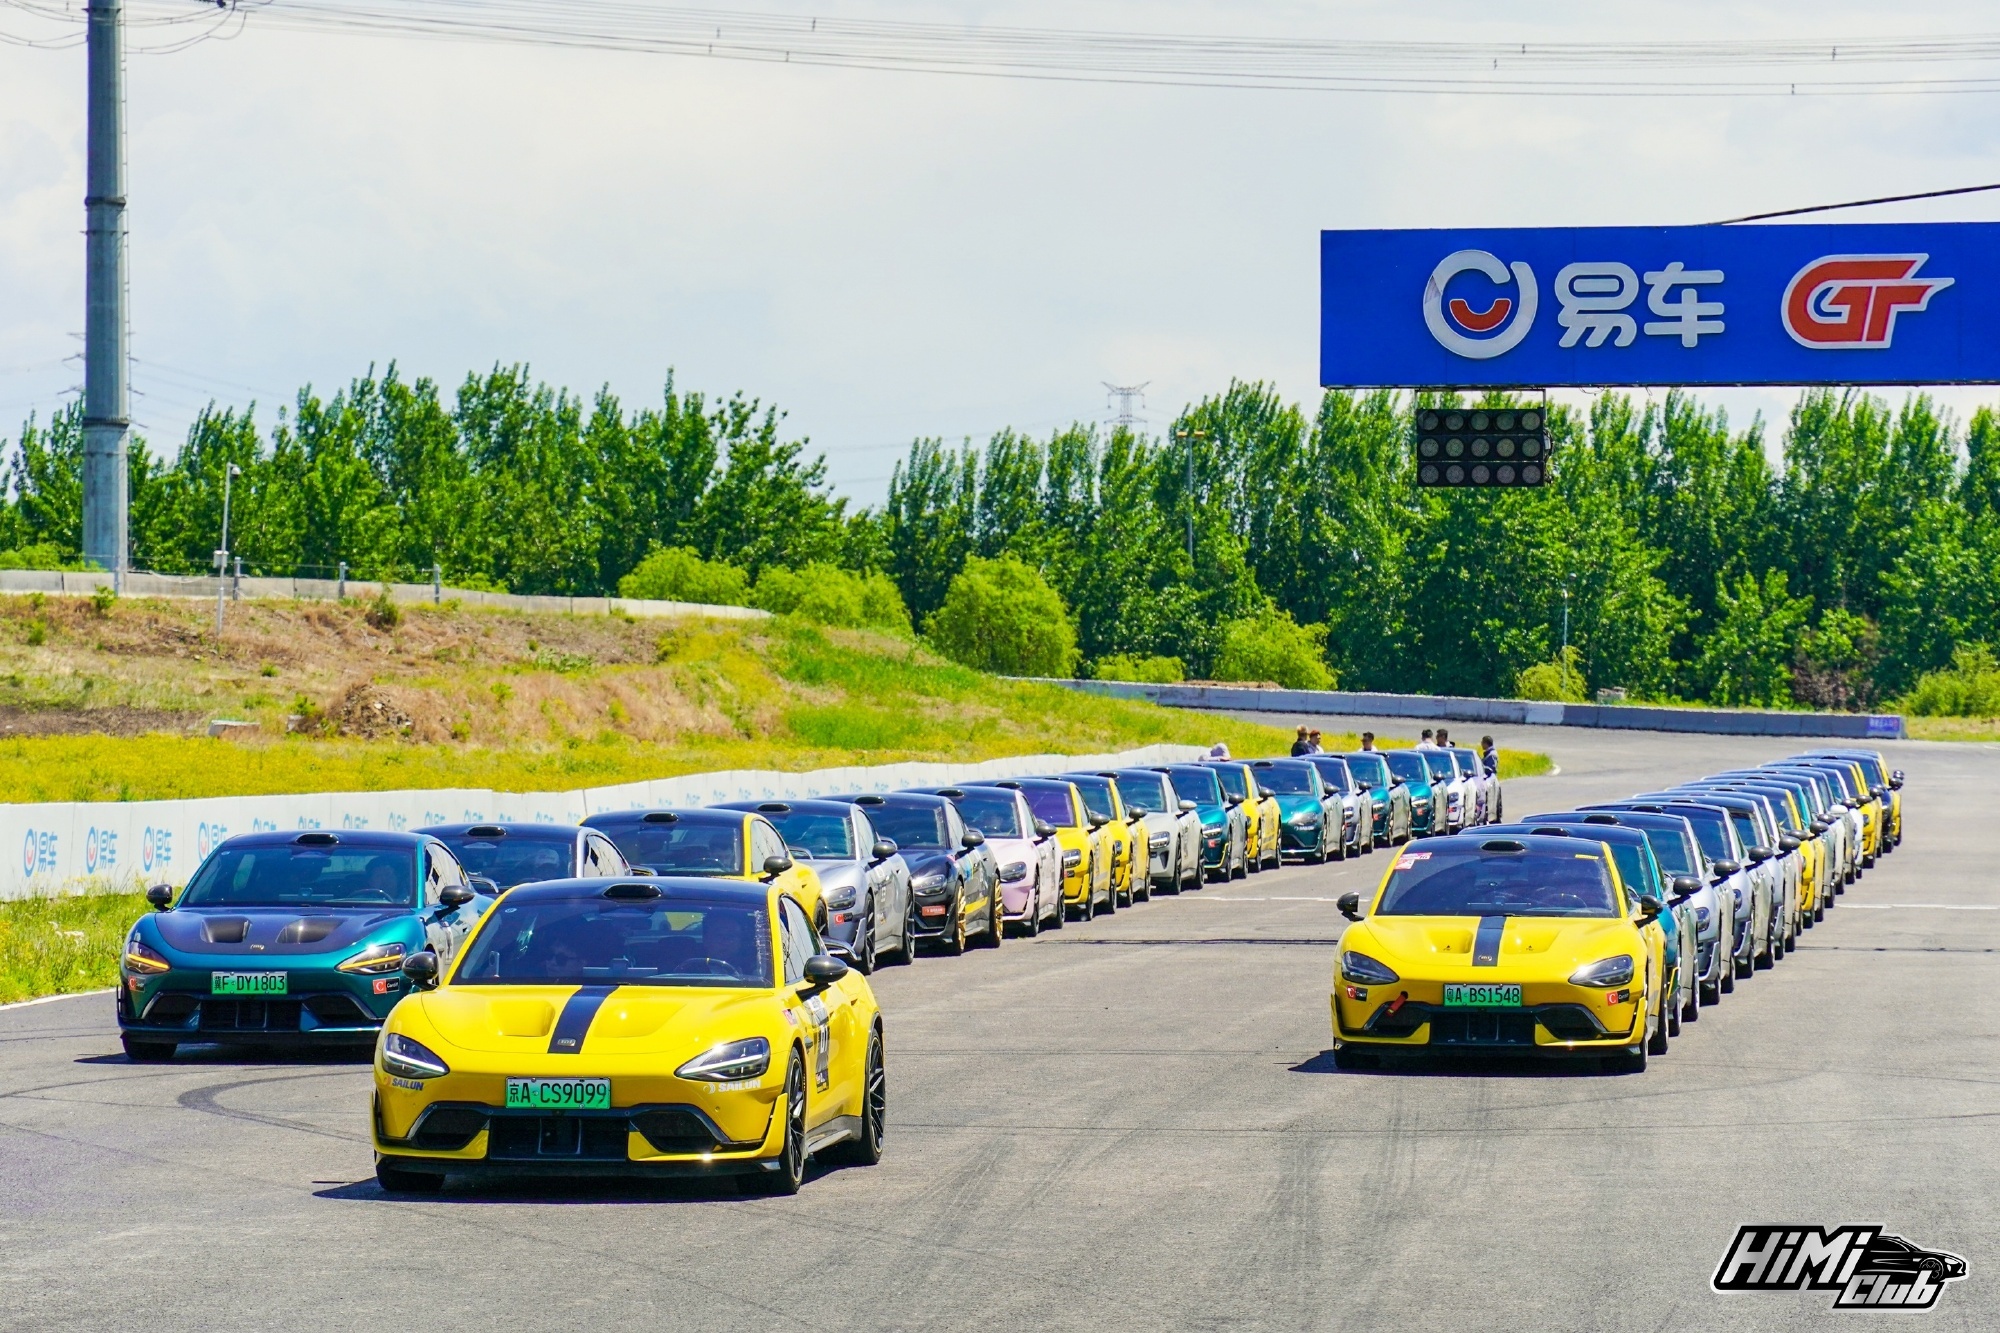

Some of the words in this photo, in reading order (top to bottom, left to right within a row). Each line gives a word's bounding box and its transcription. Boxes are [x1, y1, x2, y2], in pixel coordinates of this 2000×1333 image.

[1554, 262, 1725, 347] 易车
[1781, 253, 1955, 349] GT
[38, 831, 58, 872] 易车
[99, 830, 118, 869] 易车
[155, 828, 172, 867] 易车
[236, 975, 285, 991] DY1803
[1469, 987, 1520, 1003] BS1548
[392, 1078, 425, 1091] SAILUN
[540, 1082, 607, 1104] CS9099
[718, 1080, 761, 1093] SAILUN
